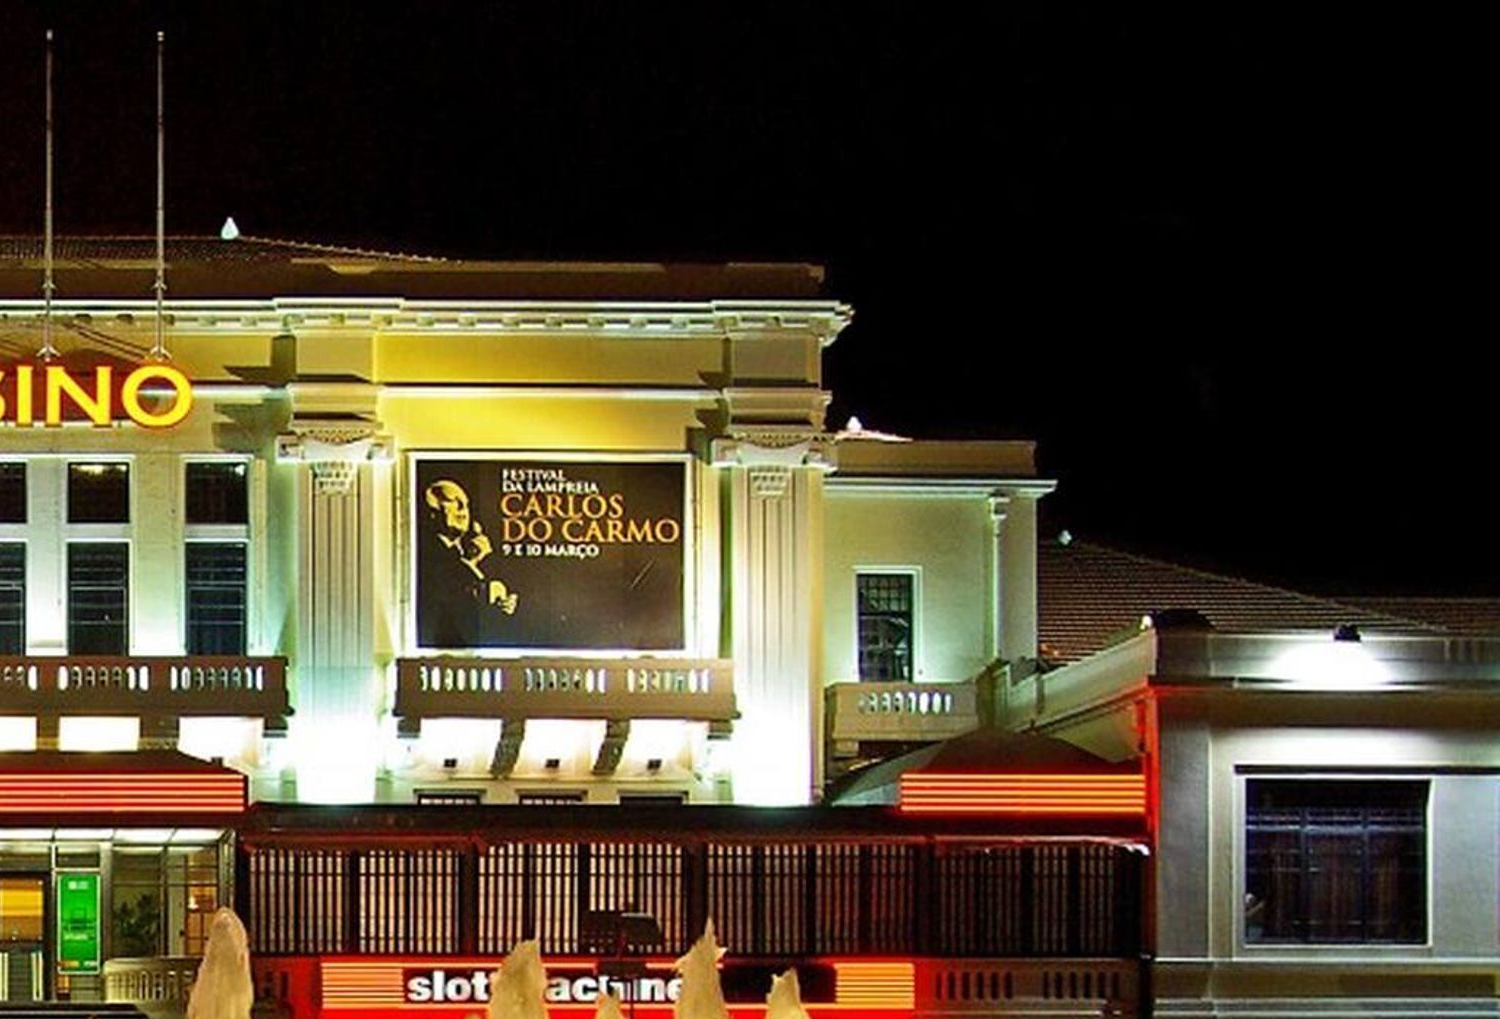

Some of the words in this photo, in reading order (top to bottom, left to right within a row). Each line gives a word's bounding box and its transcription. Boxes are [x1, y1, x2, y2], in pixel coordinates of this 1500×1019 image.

[502, 469, 566, 481] FESTIVAL
[502, 481, 524, 493] DA
[527, 482, 599, 494] LAMPREIA
[501, 493, 624, 519] CARLOS
[503, 518, 552, 542] DO
[562, 519, 680, 542] CARMO
[502, 544, 512, 556] 9
[527, 544, 542, 556] 10
[545, 544, 600, 559] MARÇO
[407, 971, 490, 1001] slot
